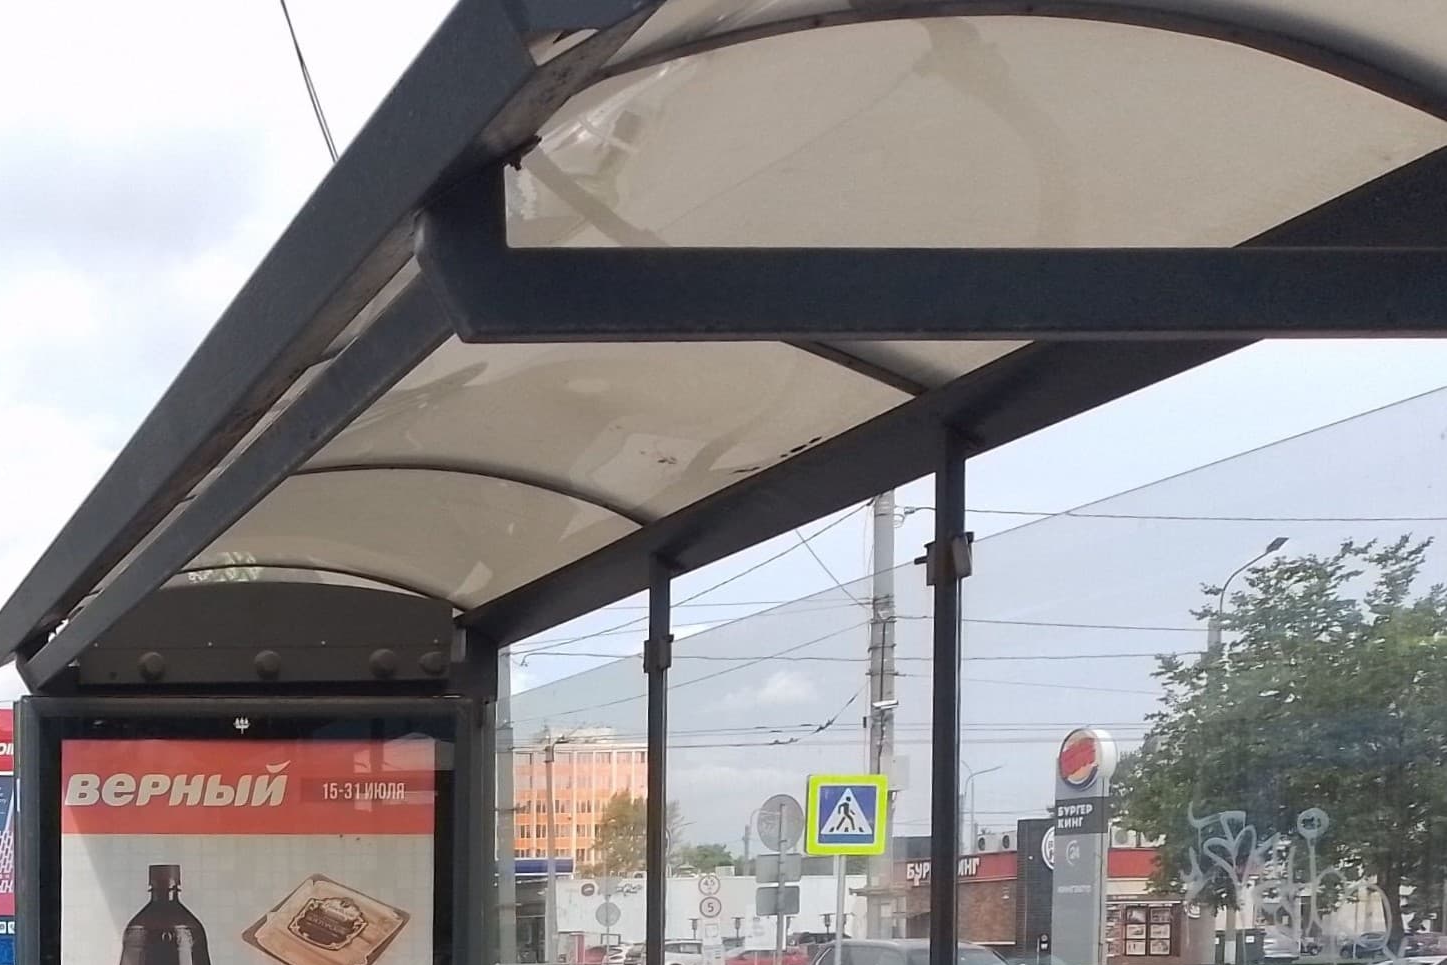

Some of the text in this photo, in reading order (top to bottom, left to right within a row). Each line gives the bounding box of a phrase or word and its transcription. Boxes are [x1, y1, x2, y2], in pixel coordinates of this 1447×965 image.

[322, 782, 405, 800] 15-31 ИЮЛЯ
[1057, 804, 1093, 817] БУРГЕР
[1057, 816, 1084, 829] КИНГ
[958, 857, 980, 876] ИНГ
[707, 902, 715, 913] 5
